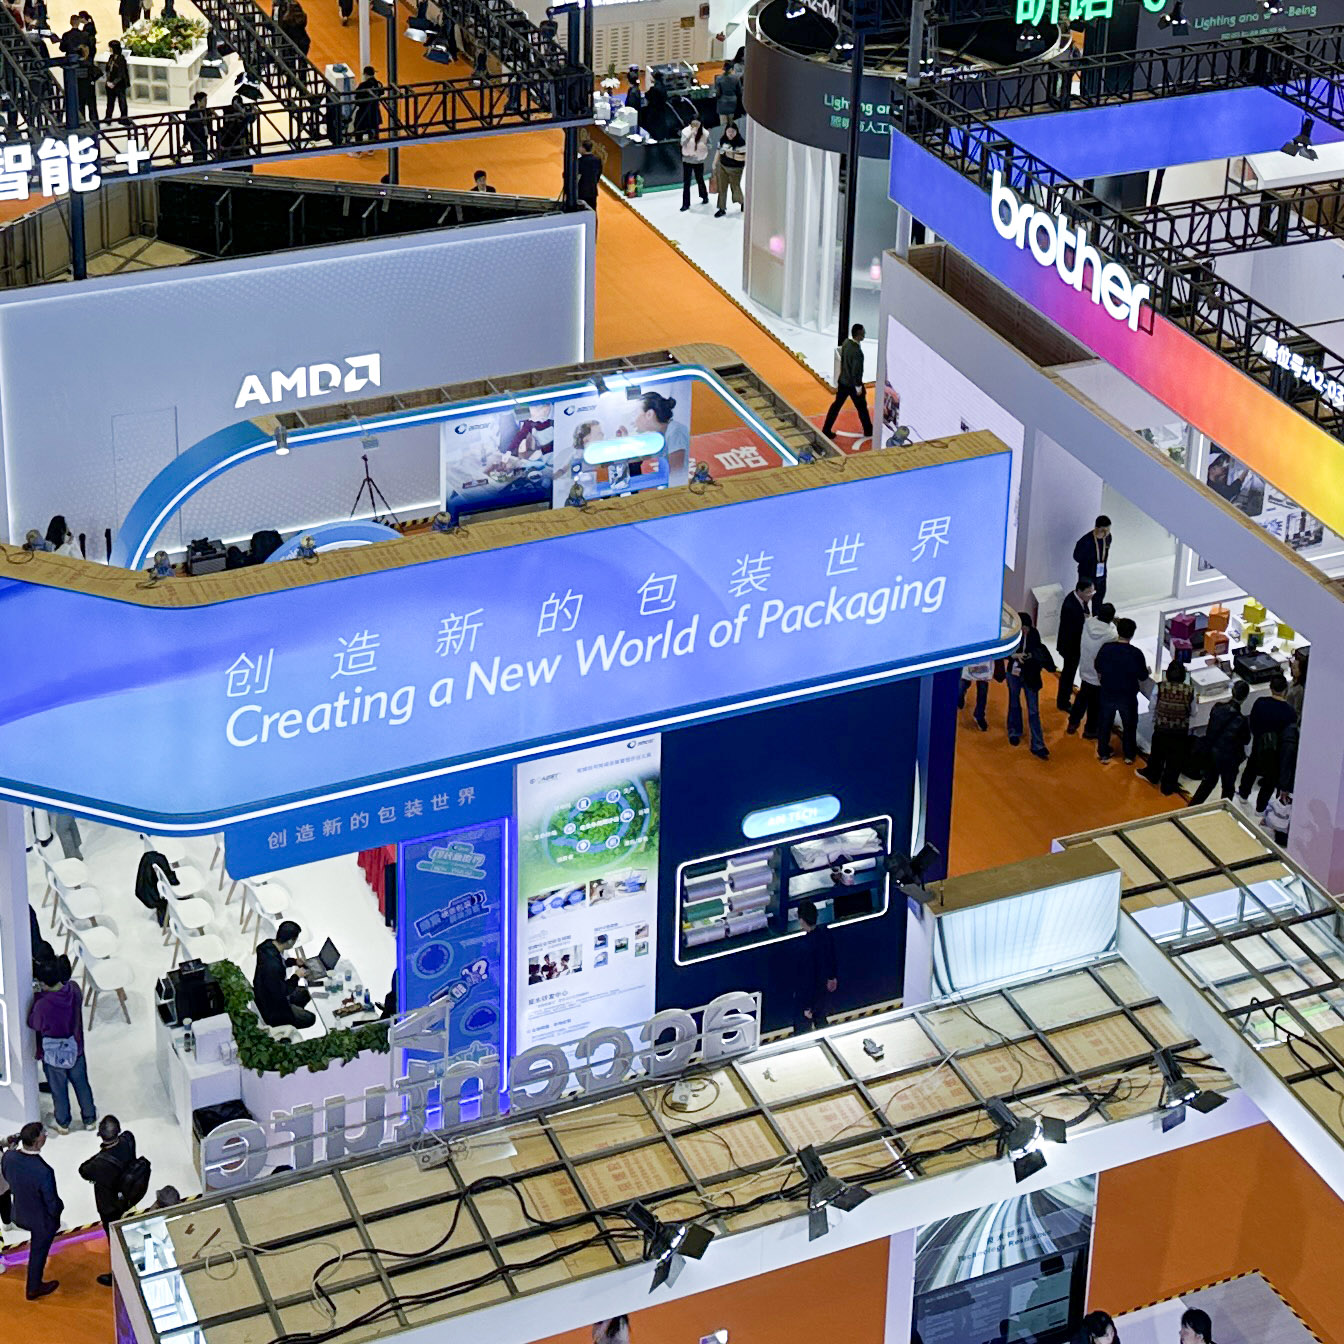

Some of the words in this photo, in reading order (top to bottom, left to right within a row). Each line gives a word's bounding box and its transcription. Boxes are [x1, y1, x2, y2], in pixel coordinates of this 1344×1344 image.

[1194, 11, 1236, 30] Lighting
[990, 168, 1152, 333] brother
[234, 362, 344, 409] AMD
[224, 516, 953, 702] 创造新的包装世界
[225, 675, 416, 749] Creating
[429, 678, 454, 707] a
[465, 651, 561, 702] New
[576, 612, 697, 677] World
[707, 603, 746, 649] of
[755, 570, 946, 641] Packaging
[267, 786, 477, 850] 创造新的包装世界
